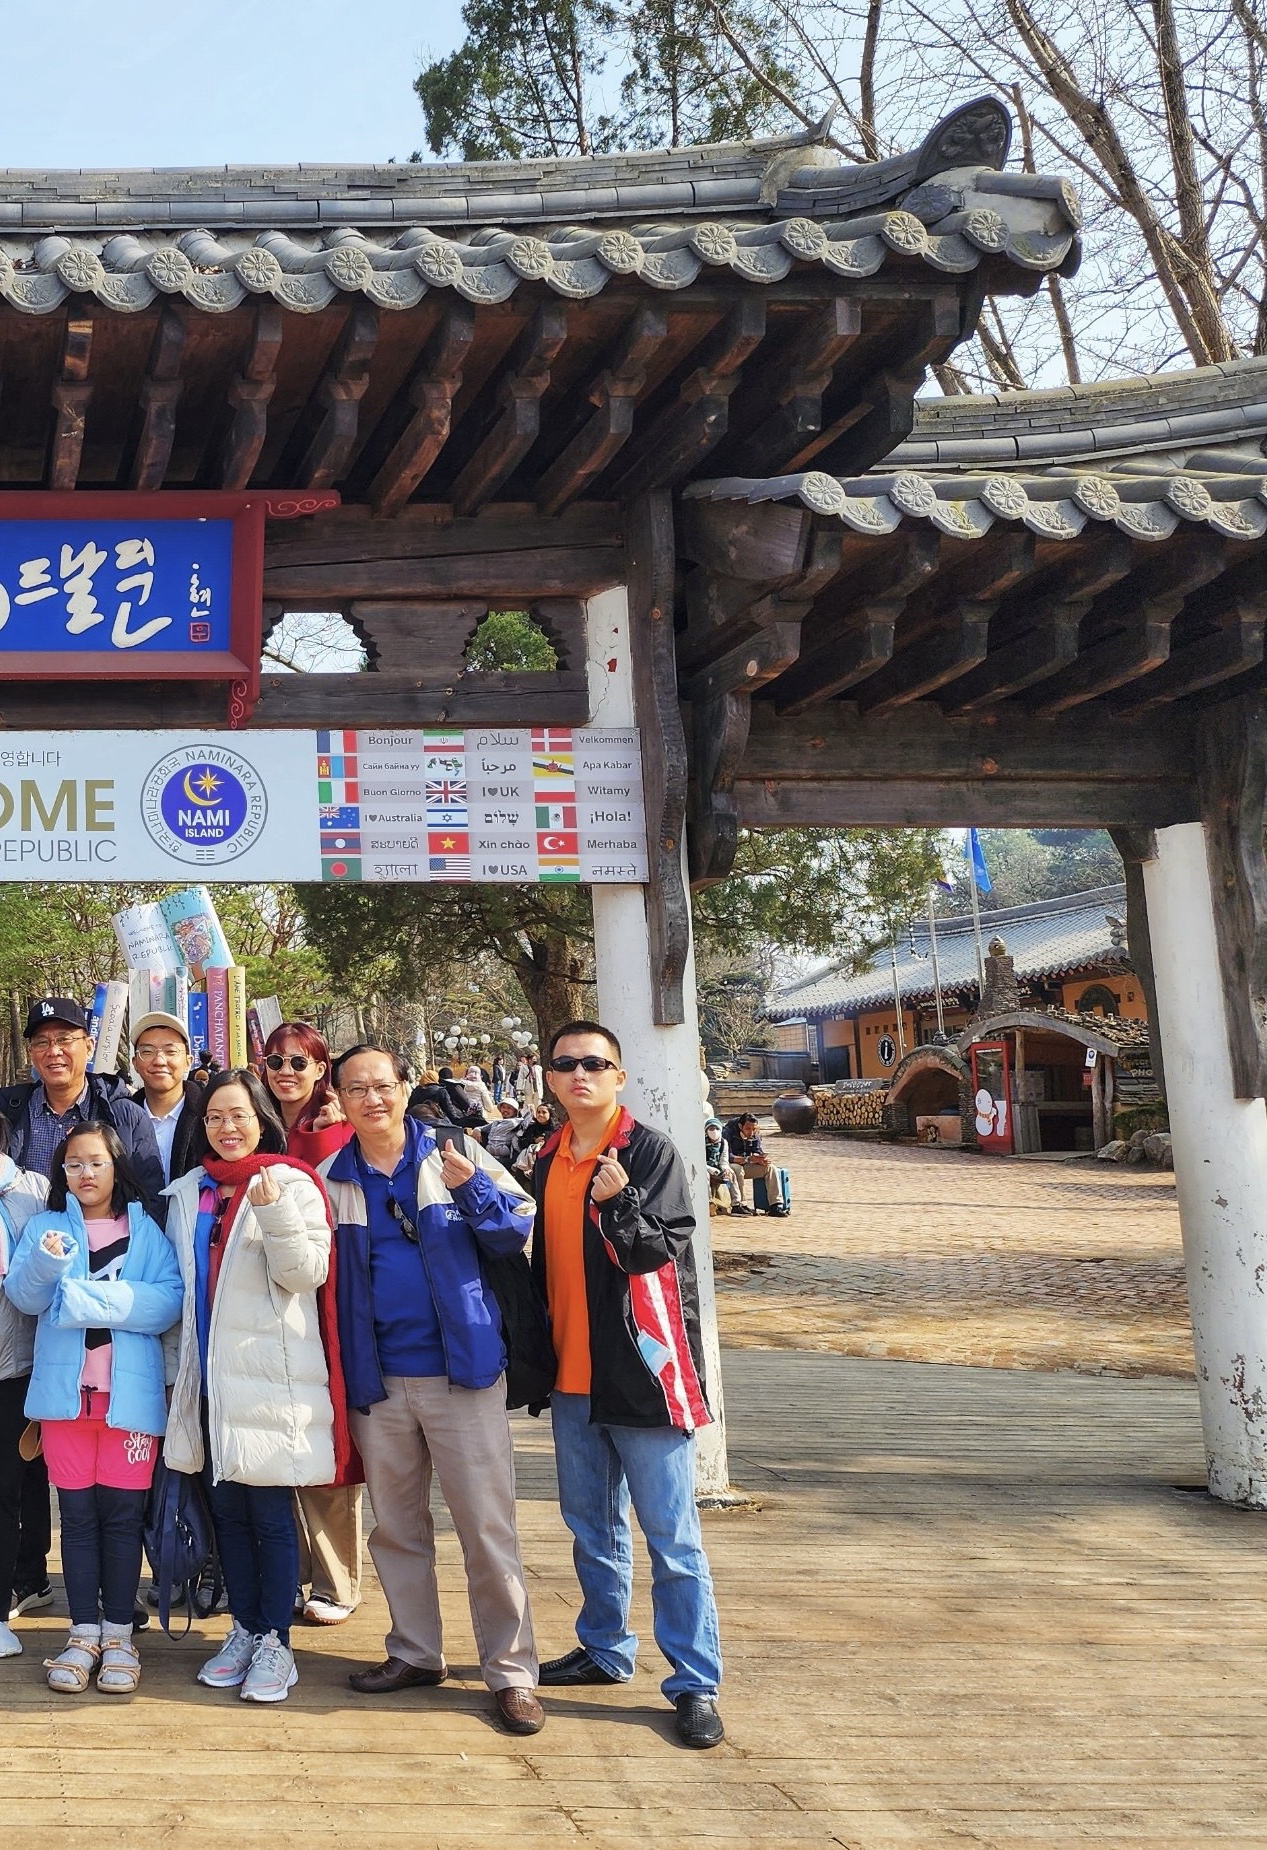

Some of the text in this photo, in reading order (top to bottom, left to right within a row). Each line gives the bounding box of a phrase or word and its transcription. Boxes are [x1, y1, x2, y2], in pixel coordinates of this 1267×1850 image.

[369, 735, 414, 747] Bonjour
[477, 733, 519, 750] سلام
[579, 735, 634, 745] Velkommen
[363, 762, 383, 770] Сайн
[583, 760, 633, 771] Apa Kabar
[364, 788, 422, 796] Buon Giorno
[588, 786, 631, 798] Witamy
[185, 749, 262, 853] NAMINARA REPUBLIC
[178, 809, 230, 827] NAMI
[591, 811, 632, 823] ¡Hola!
[185, 828, 224, 838] ISLAND
[479, 839, 531, 849] Xin chào
[588, 839, 638, 849] Merhaba
[592, 863, 638, 875] नमस्ते
[128, 932, 170, 950] NAMINARA
